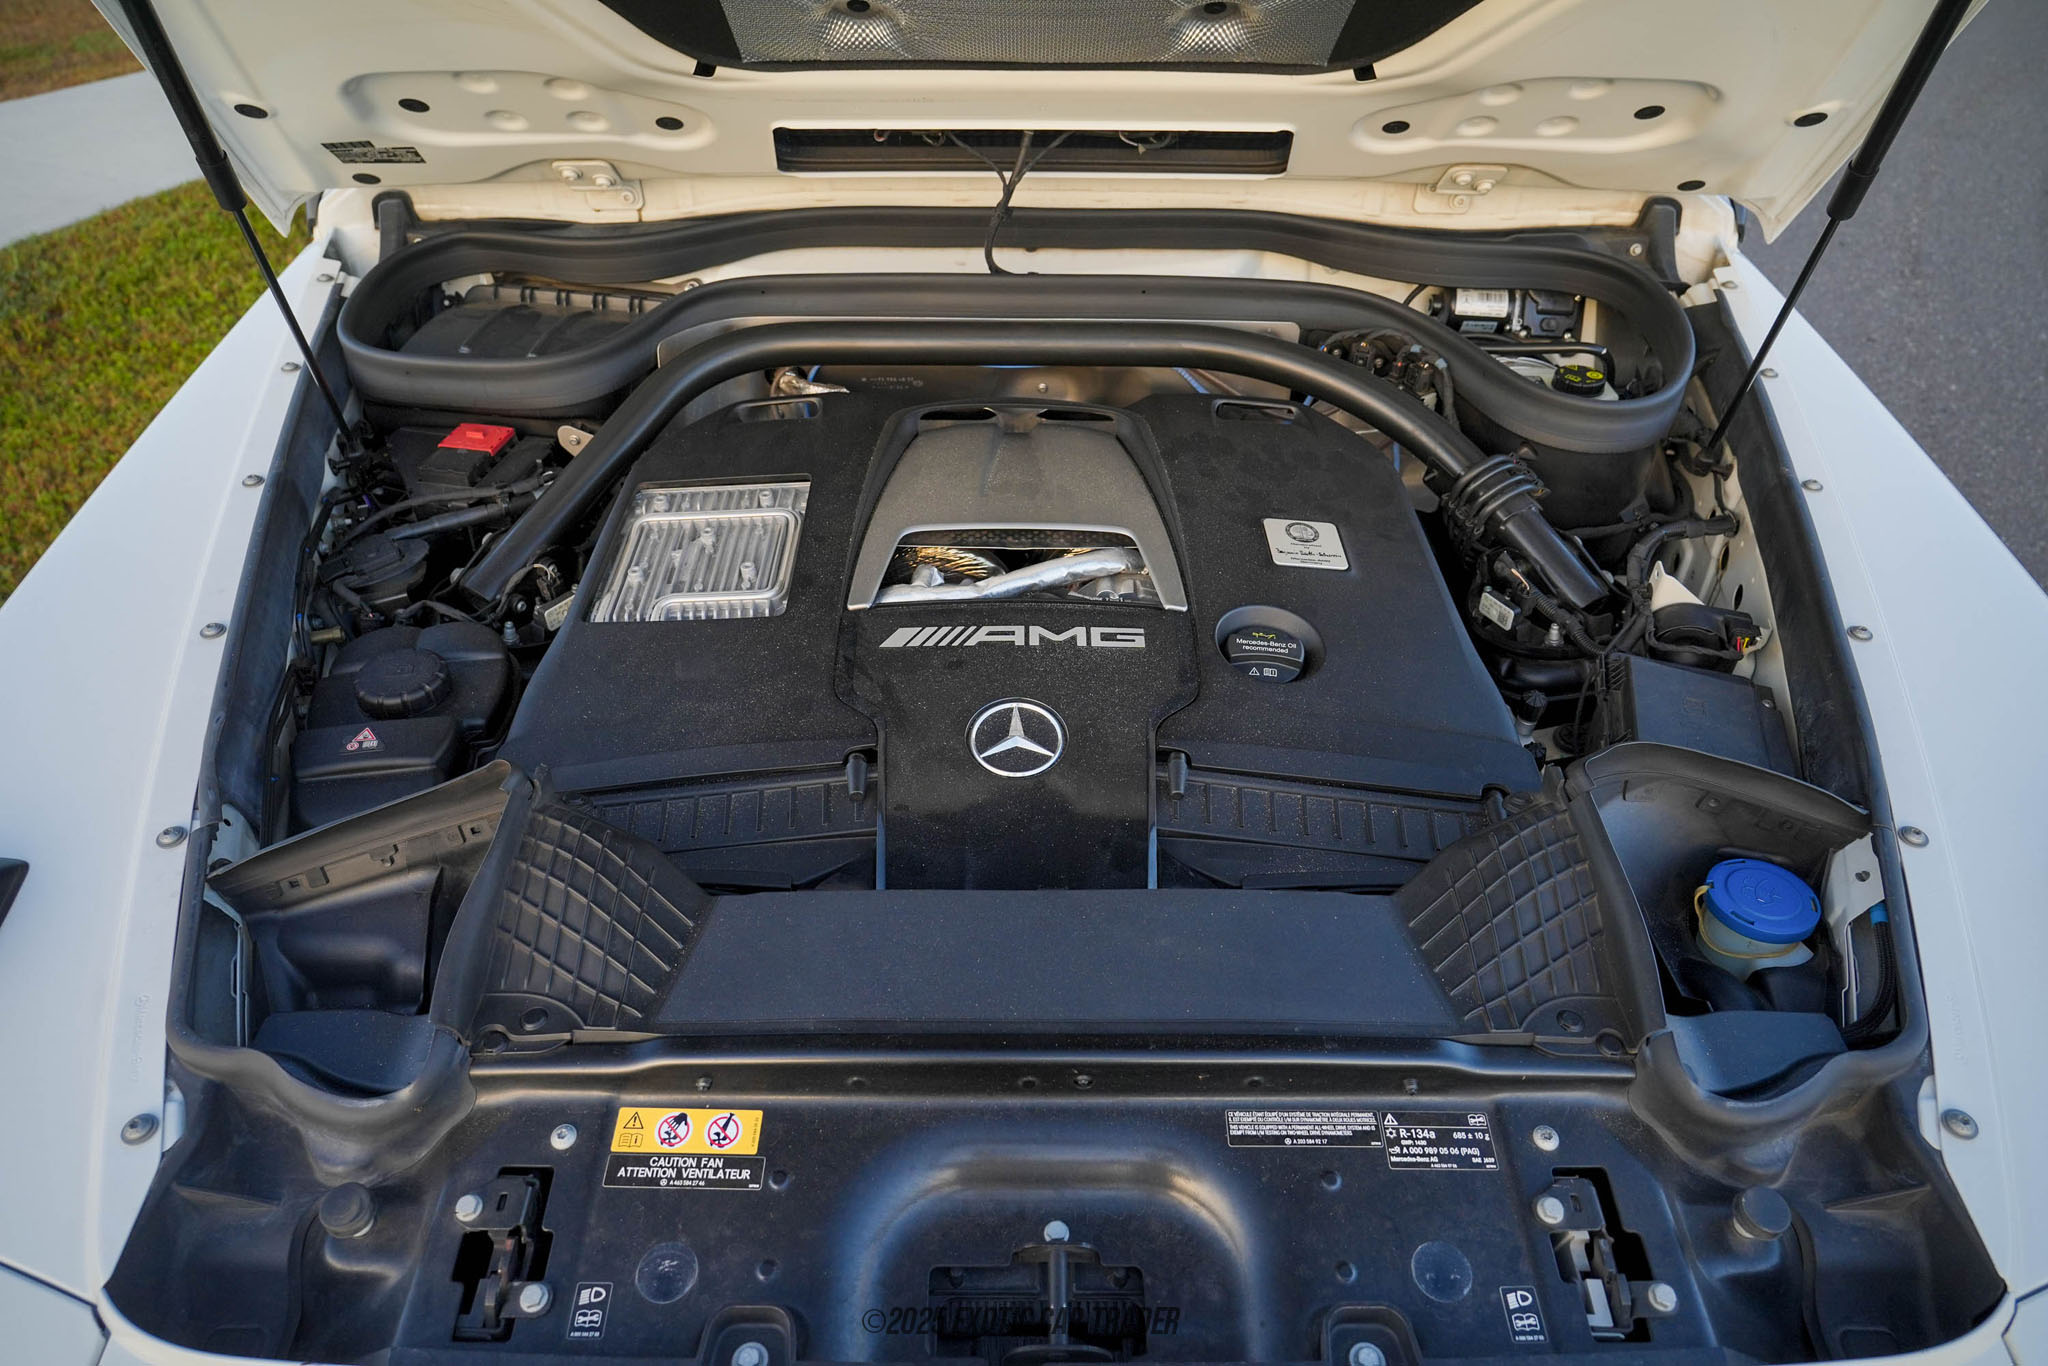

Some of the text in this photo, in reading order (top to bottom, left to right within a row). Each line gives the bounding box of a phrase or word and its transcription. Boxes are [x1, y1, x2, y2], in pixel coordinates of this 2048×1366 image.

[963, 626, 1145, 647] AMG
[1236, 638, 1286, 648] Mercedes-Benz
[1242, 645, 1289, 653] recommended
[1400, 1128, 1436, 1139] R-134a
[1485, 1133, 1490, 1141] g
[1460, 1148, 1480, 1156] (PAG)
[650, 1157, 724, 1168] CAUTION FAN
[617, 1167, 750, 1179] ATTENTION VENTILATEUR
